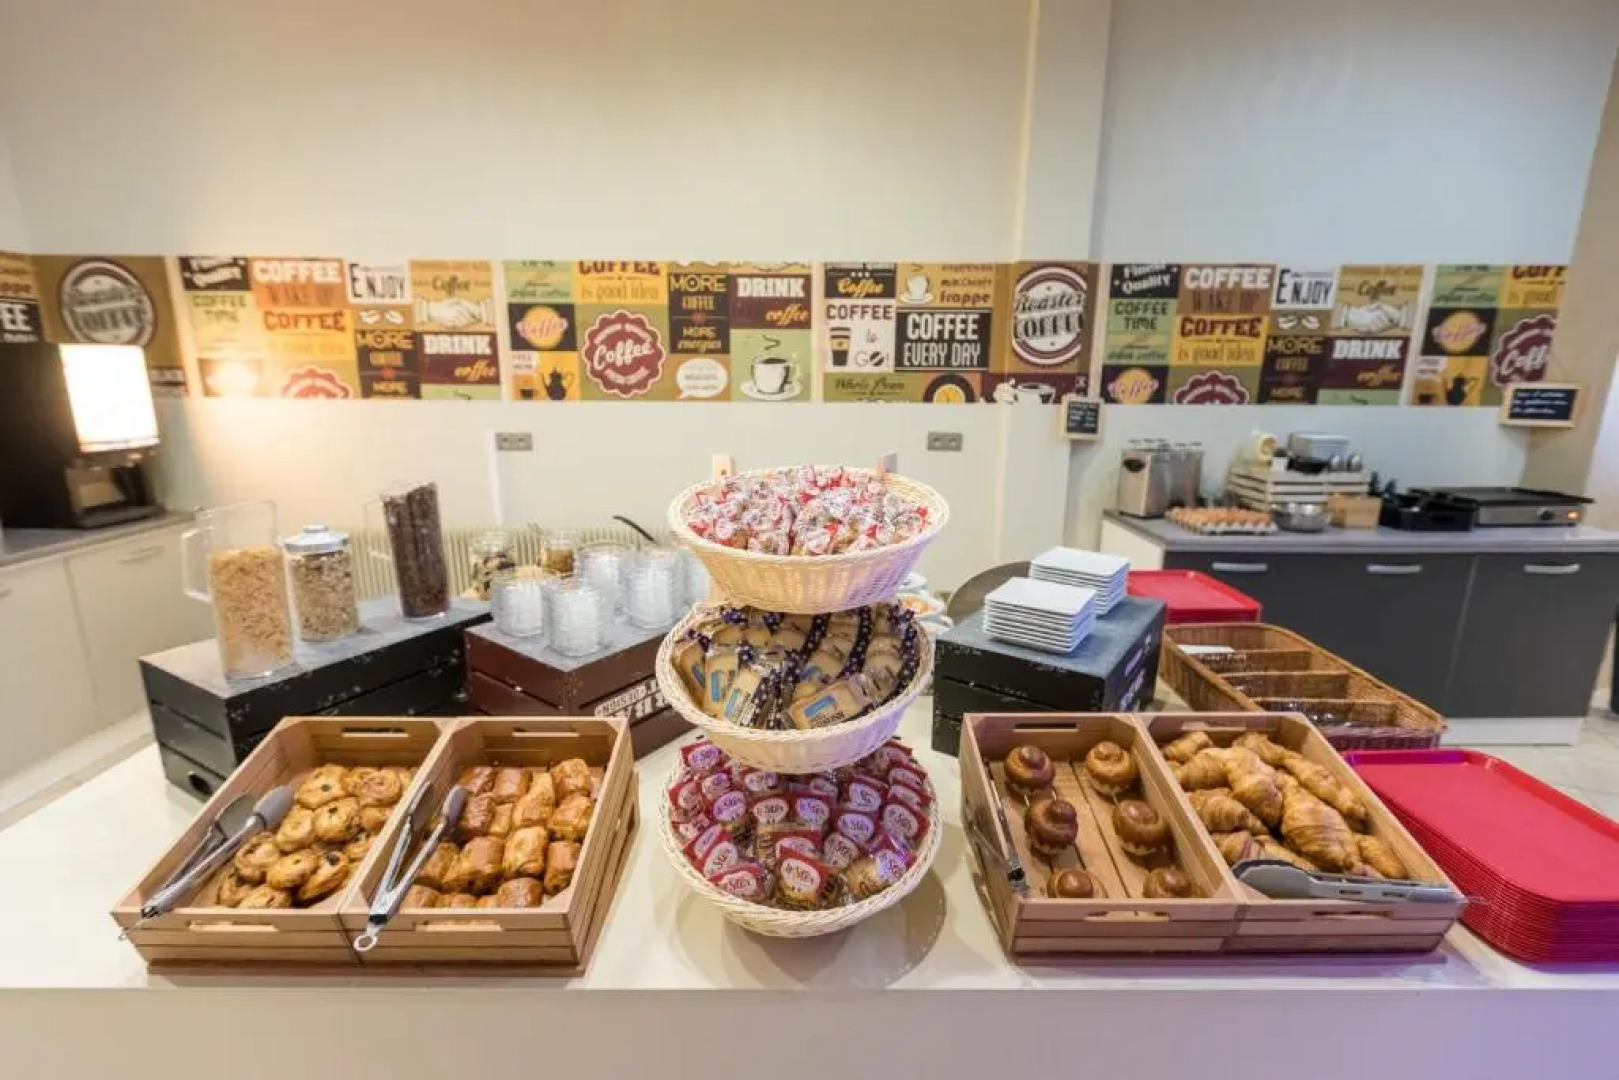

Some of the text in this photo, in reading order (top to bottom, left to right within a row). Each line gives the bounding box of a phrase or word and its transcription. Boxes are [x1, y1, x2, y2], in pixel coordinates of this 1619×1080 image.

[253, 260, 343, 284] COFFEE
[1185, 267, 1272, 290] COFFEE
[669, 274, 727, 292] MORE
[736, 277, 806, 298] DRINK
[1276, 268, 1333, 304] ENJOY
[940, 290, 990, 306] frappe
[1115, 301, 1169, 315] COFFEE
[263, 311, 346, 332] COFFEE
[765, 303, 810, 327] coffee
[826, 304, 893, 320] COFFEE
[907, 313, 981, 341] COFFEE
[1123, 317, 1157, 330] TIME
[1180, 317, 1262, 338] COFFEE
[423, 334, 493, 355] DRINK
[593, 339, 655, 371] Coffee
[903, 342, 981, 367] EVERY DAY
[1267, 337, 1323, 354] MORE
[1332, 339, 1404, 360] DRINK
